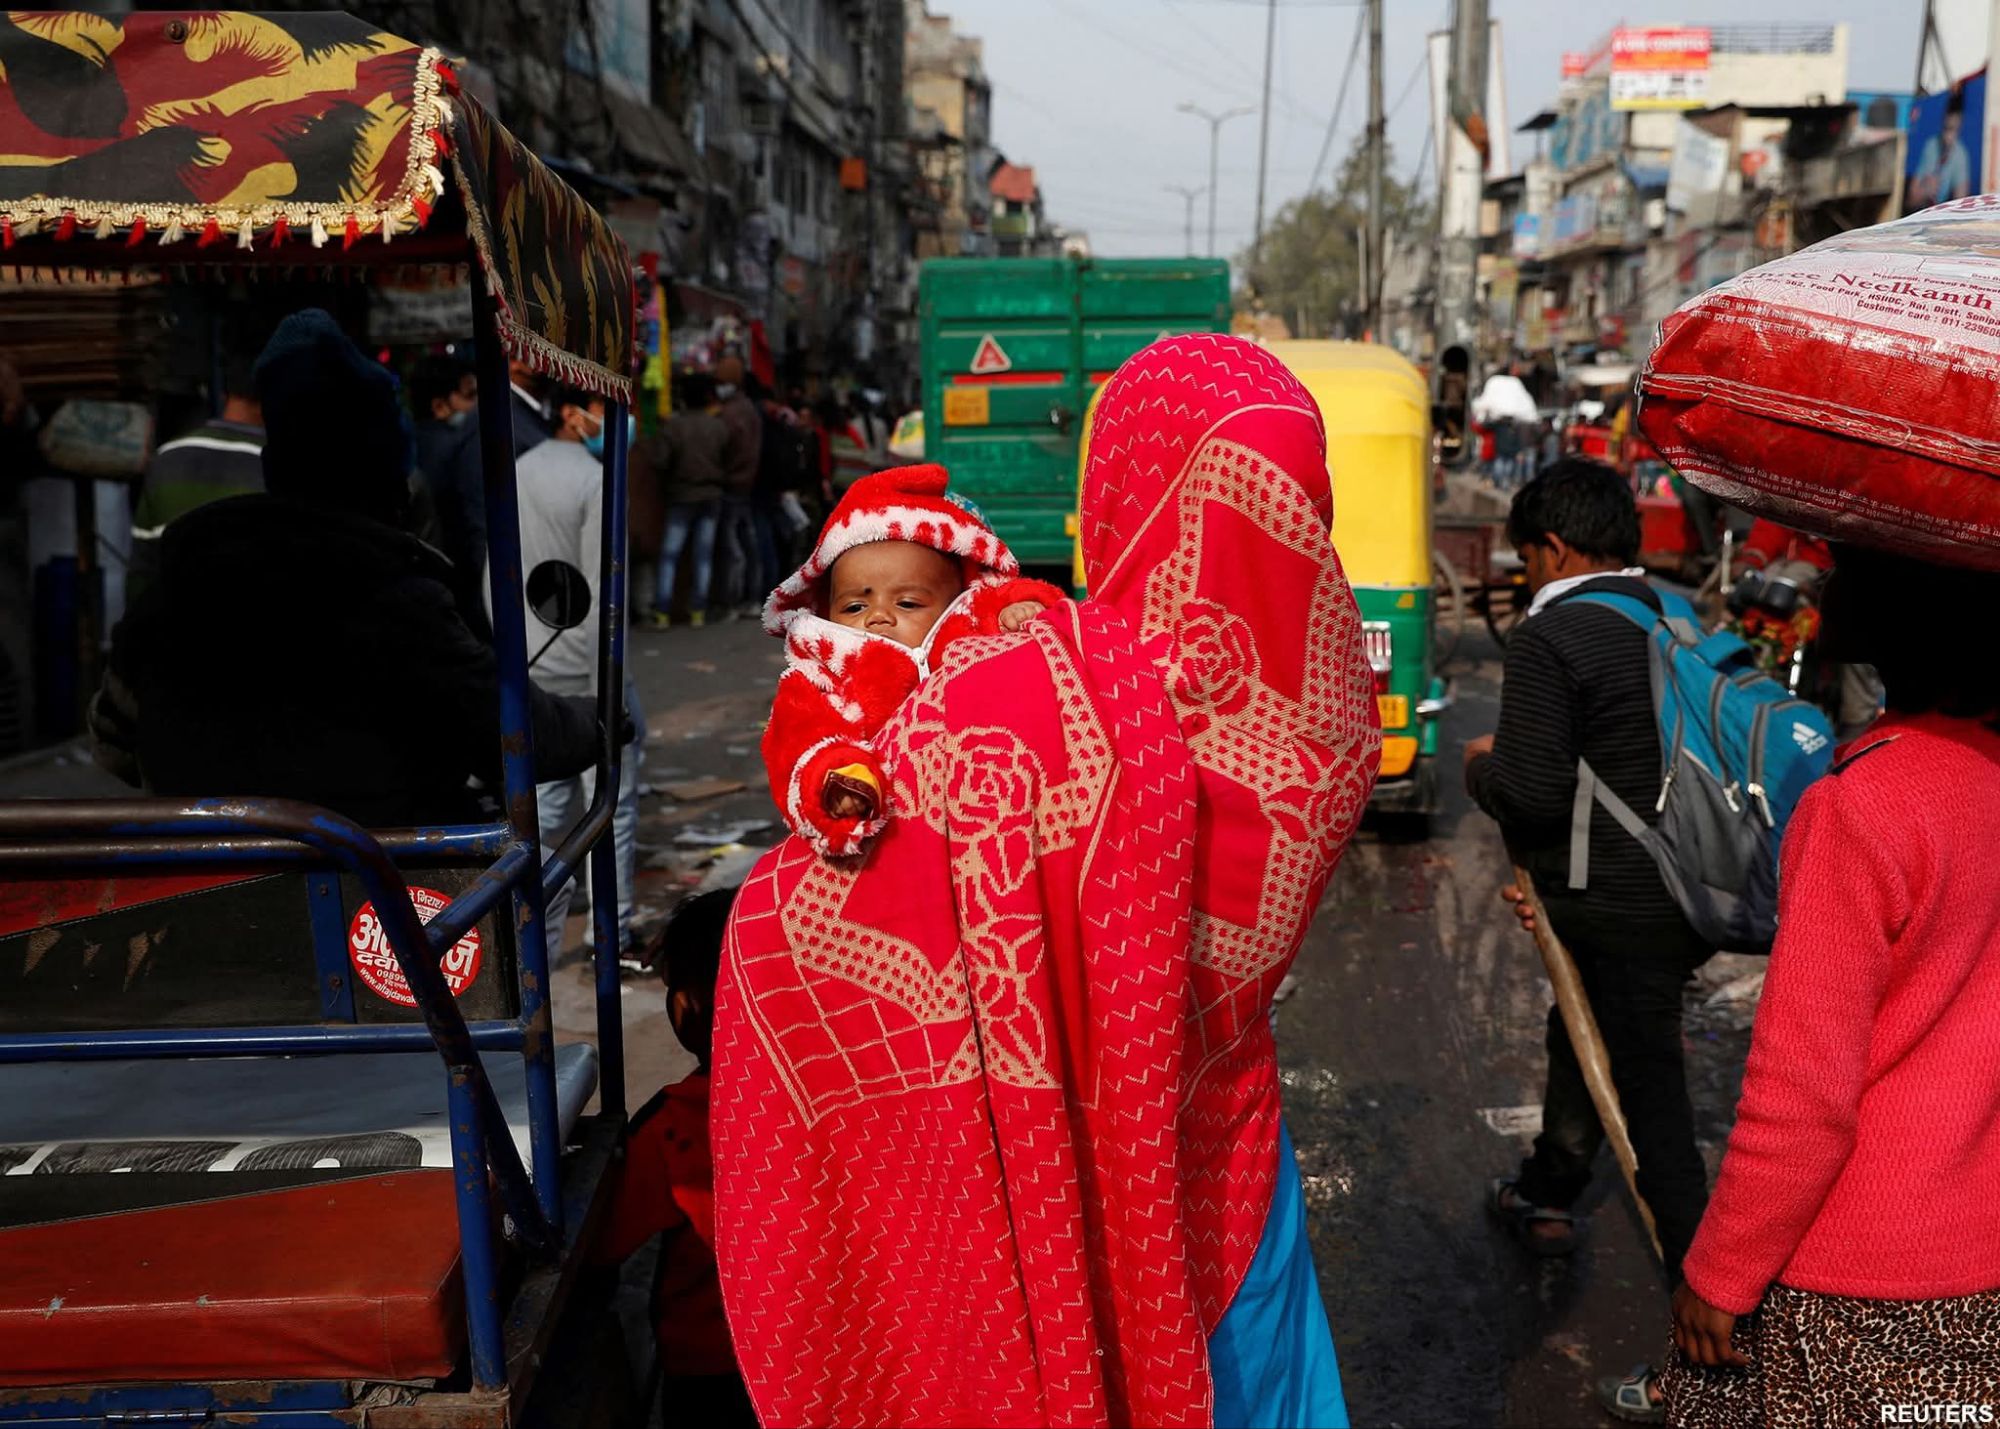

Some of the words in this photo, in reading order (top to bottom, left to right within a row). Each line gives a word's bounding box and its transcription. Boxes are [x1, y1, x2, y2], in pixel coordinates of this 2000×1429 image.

[1811, 282, 1835, 293] Food
[1830, 273, 1992, 310] Neelkanth
[1857, 299, 1905, 316] Customer
[1908, 311, 1931, 321] care
